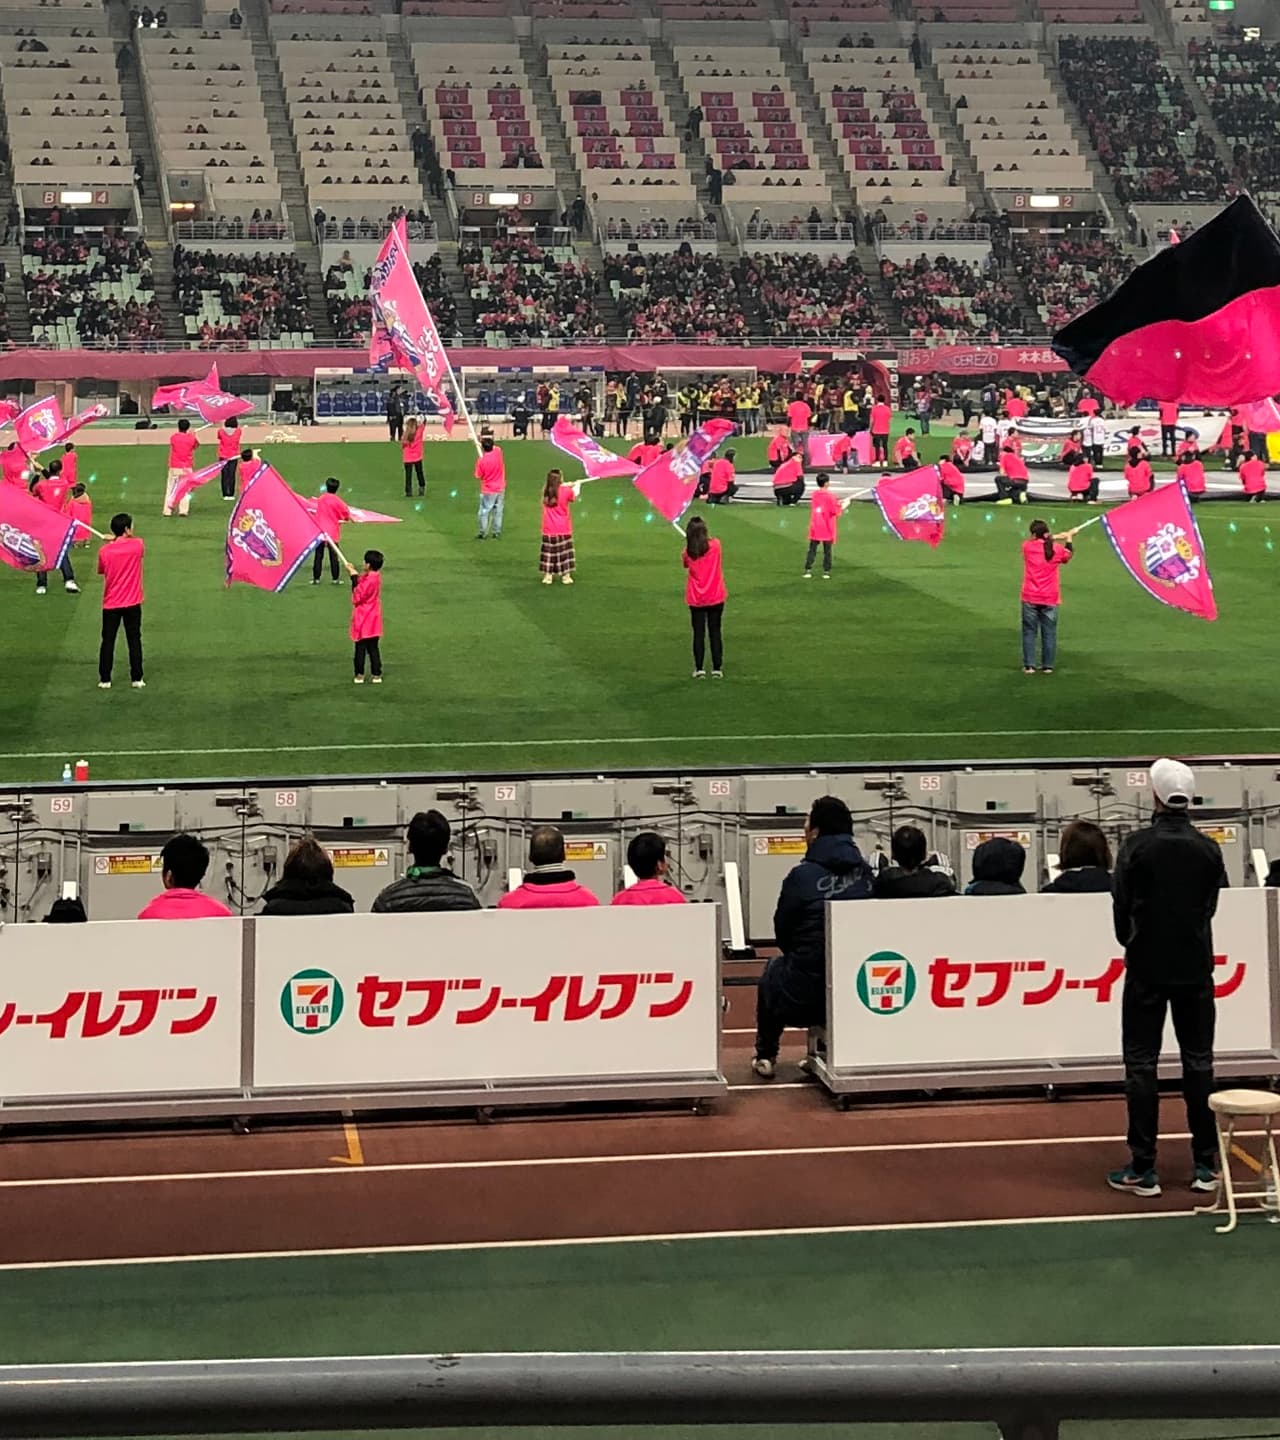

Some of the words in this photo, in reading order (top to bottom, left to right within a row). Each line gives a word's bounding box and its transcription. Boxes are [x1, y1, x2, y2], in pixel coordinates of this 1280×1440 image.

[45, 192, 54, 203] B
[98, 192, 107, 203] 4
[474, 193, 483, 204] B
[524, 193, 532, 204] 3
[1015, 196, 1024, 206] B
[1064, 196, 1072, 206] 2
[953, 353, 998, 367] CEREZO
[921, 777, 939, 789] 55
[1128, 773, 1146, 785] 54
[496, 787, 514, 799] 57
[710, 781, 728, 794] 56
[277, 793, 295, 805] 58
[52, 799, 70, 812] 59
